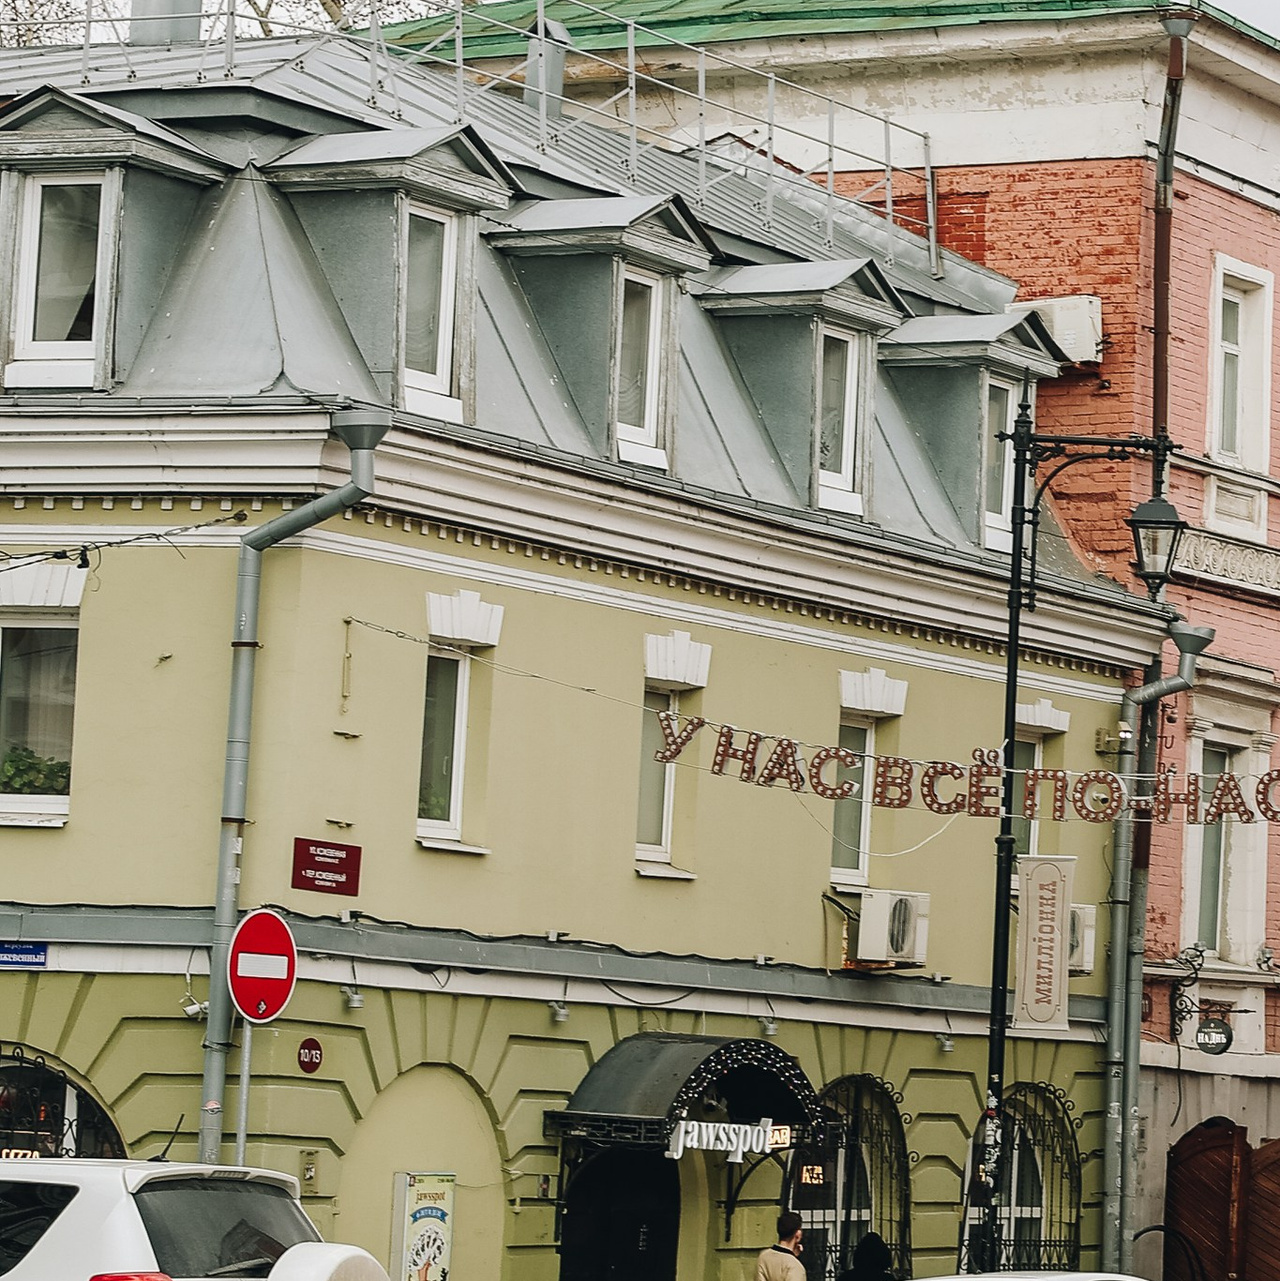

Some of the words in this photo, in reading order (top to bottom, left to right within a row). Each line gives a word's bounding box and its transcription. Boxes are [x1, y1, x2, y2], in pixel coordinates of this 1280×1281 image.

[654, 711, 704, 762] У
[711, 724, 860, 800] НАС
[872, 747, 1004, 817] ВСЁ
[664, 1117, 773, 1163] jawsspot
